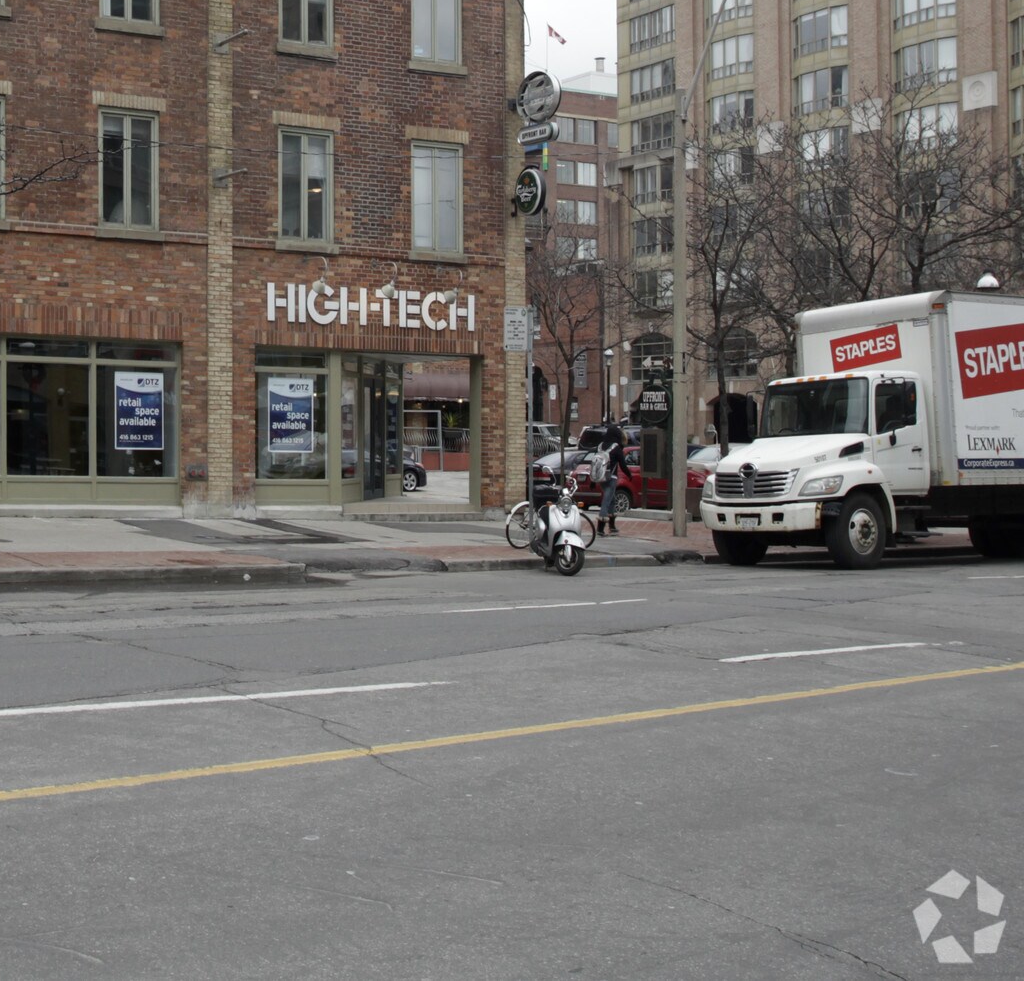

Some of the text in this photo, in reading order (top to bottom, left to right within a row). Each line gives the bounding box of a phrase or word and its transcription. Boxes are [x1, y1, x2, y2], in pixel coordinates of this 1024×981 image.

[266, 282, 475, 332] HIGH-TECH
[835, 334, 896, 362] STAPLES
[145, 378, 159, 386] DTZ
[296, 383, 309, 391] DTZ
[643, 391, 666, 402] UPFRONT
[119, 397, 142, 407] retail
[271, 402, 293, 411] retail
[639, 402, 668, 411] BAR & GRILL
[135, 407, 160, 417] space
[286, 412, 310, 421] space
[119, 416, 156, 426] available
[272, 420, 306, 430] available
[963, 459, 1015, 468] CorporateExpress.ca
